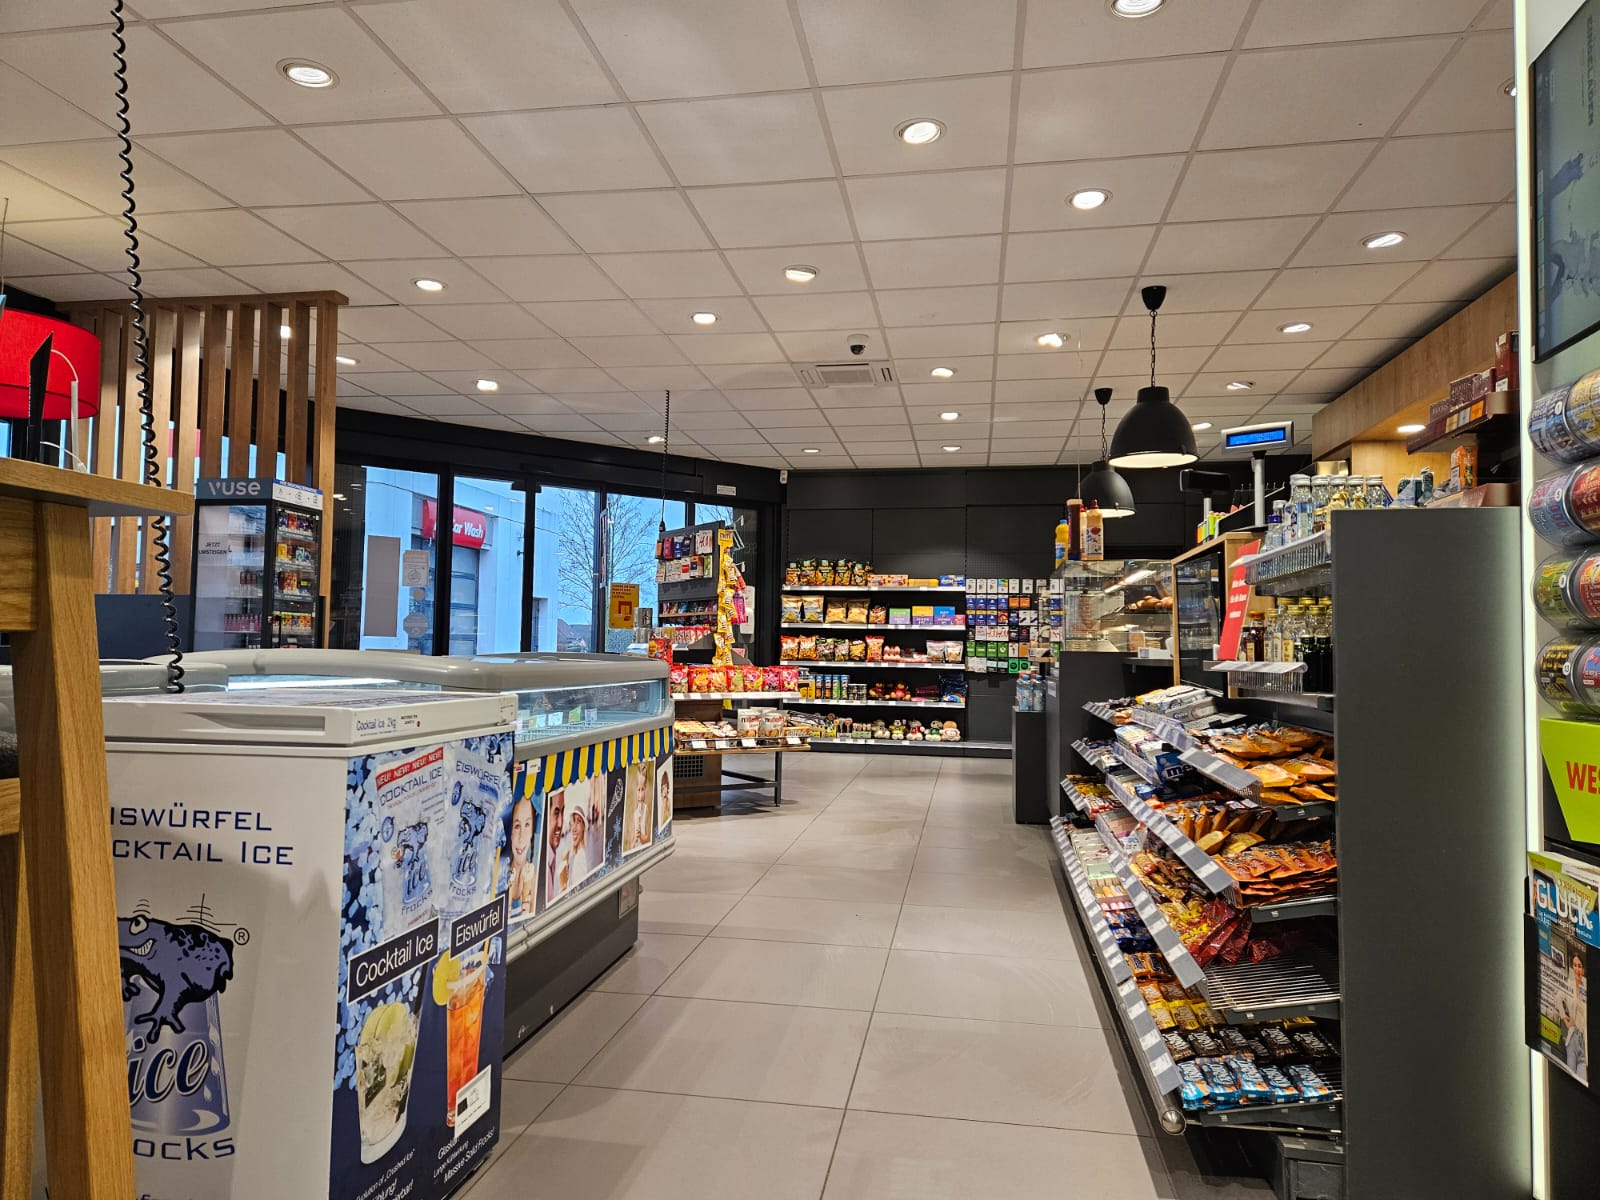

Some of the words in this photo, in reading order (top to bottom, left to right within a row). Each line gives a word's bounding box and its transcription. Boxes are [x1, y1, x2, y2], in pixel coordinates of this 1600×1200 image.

[464, 520, 484, 539] Wash
[379, 778, 428, 806] COCKTAIL
[429, 766, 443, 781] ICE
[110, 802, 272, 831] ISWÜRFEL
[112, 839, 223, 863] CKTAIL
[455, 906, 500, 947] Eiswürfel
[356, 939, 412, 987] Cocktail
[415, 934, 434, 957] Ice
[127, 1035, 210, 1106] ice
